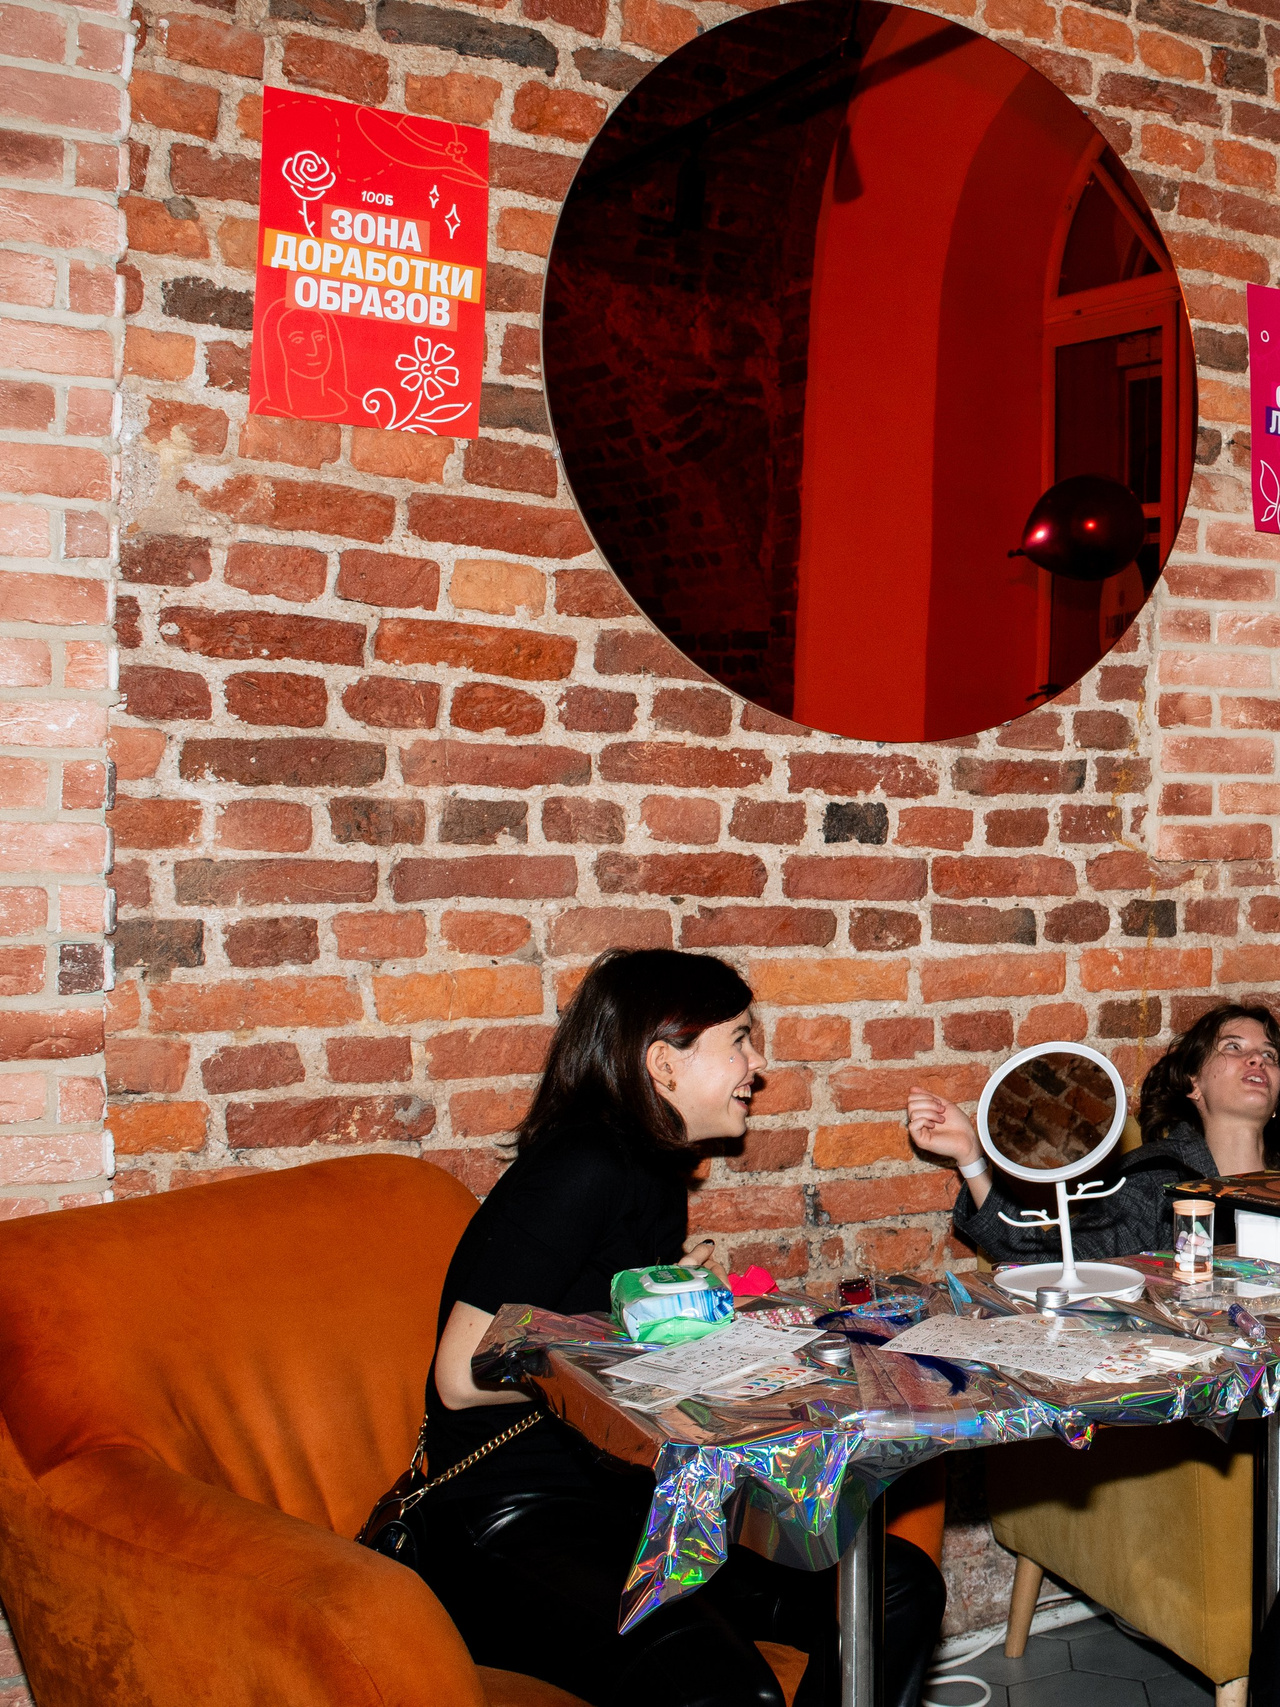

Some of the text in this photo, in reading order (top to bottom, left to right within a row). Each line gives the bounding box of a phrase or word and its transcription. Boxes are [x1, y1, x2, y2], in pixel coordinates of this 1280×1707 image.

[361, 190, 394, 206] 100Б
[330, 209, 422, 252] ЗОНА
[271, 234, 474, 299] ДОРАБОТКИ
[294, 276, 450, 327] ОБРАЗОВ
